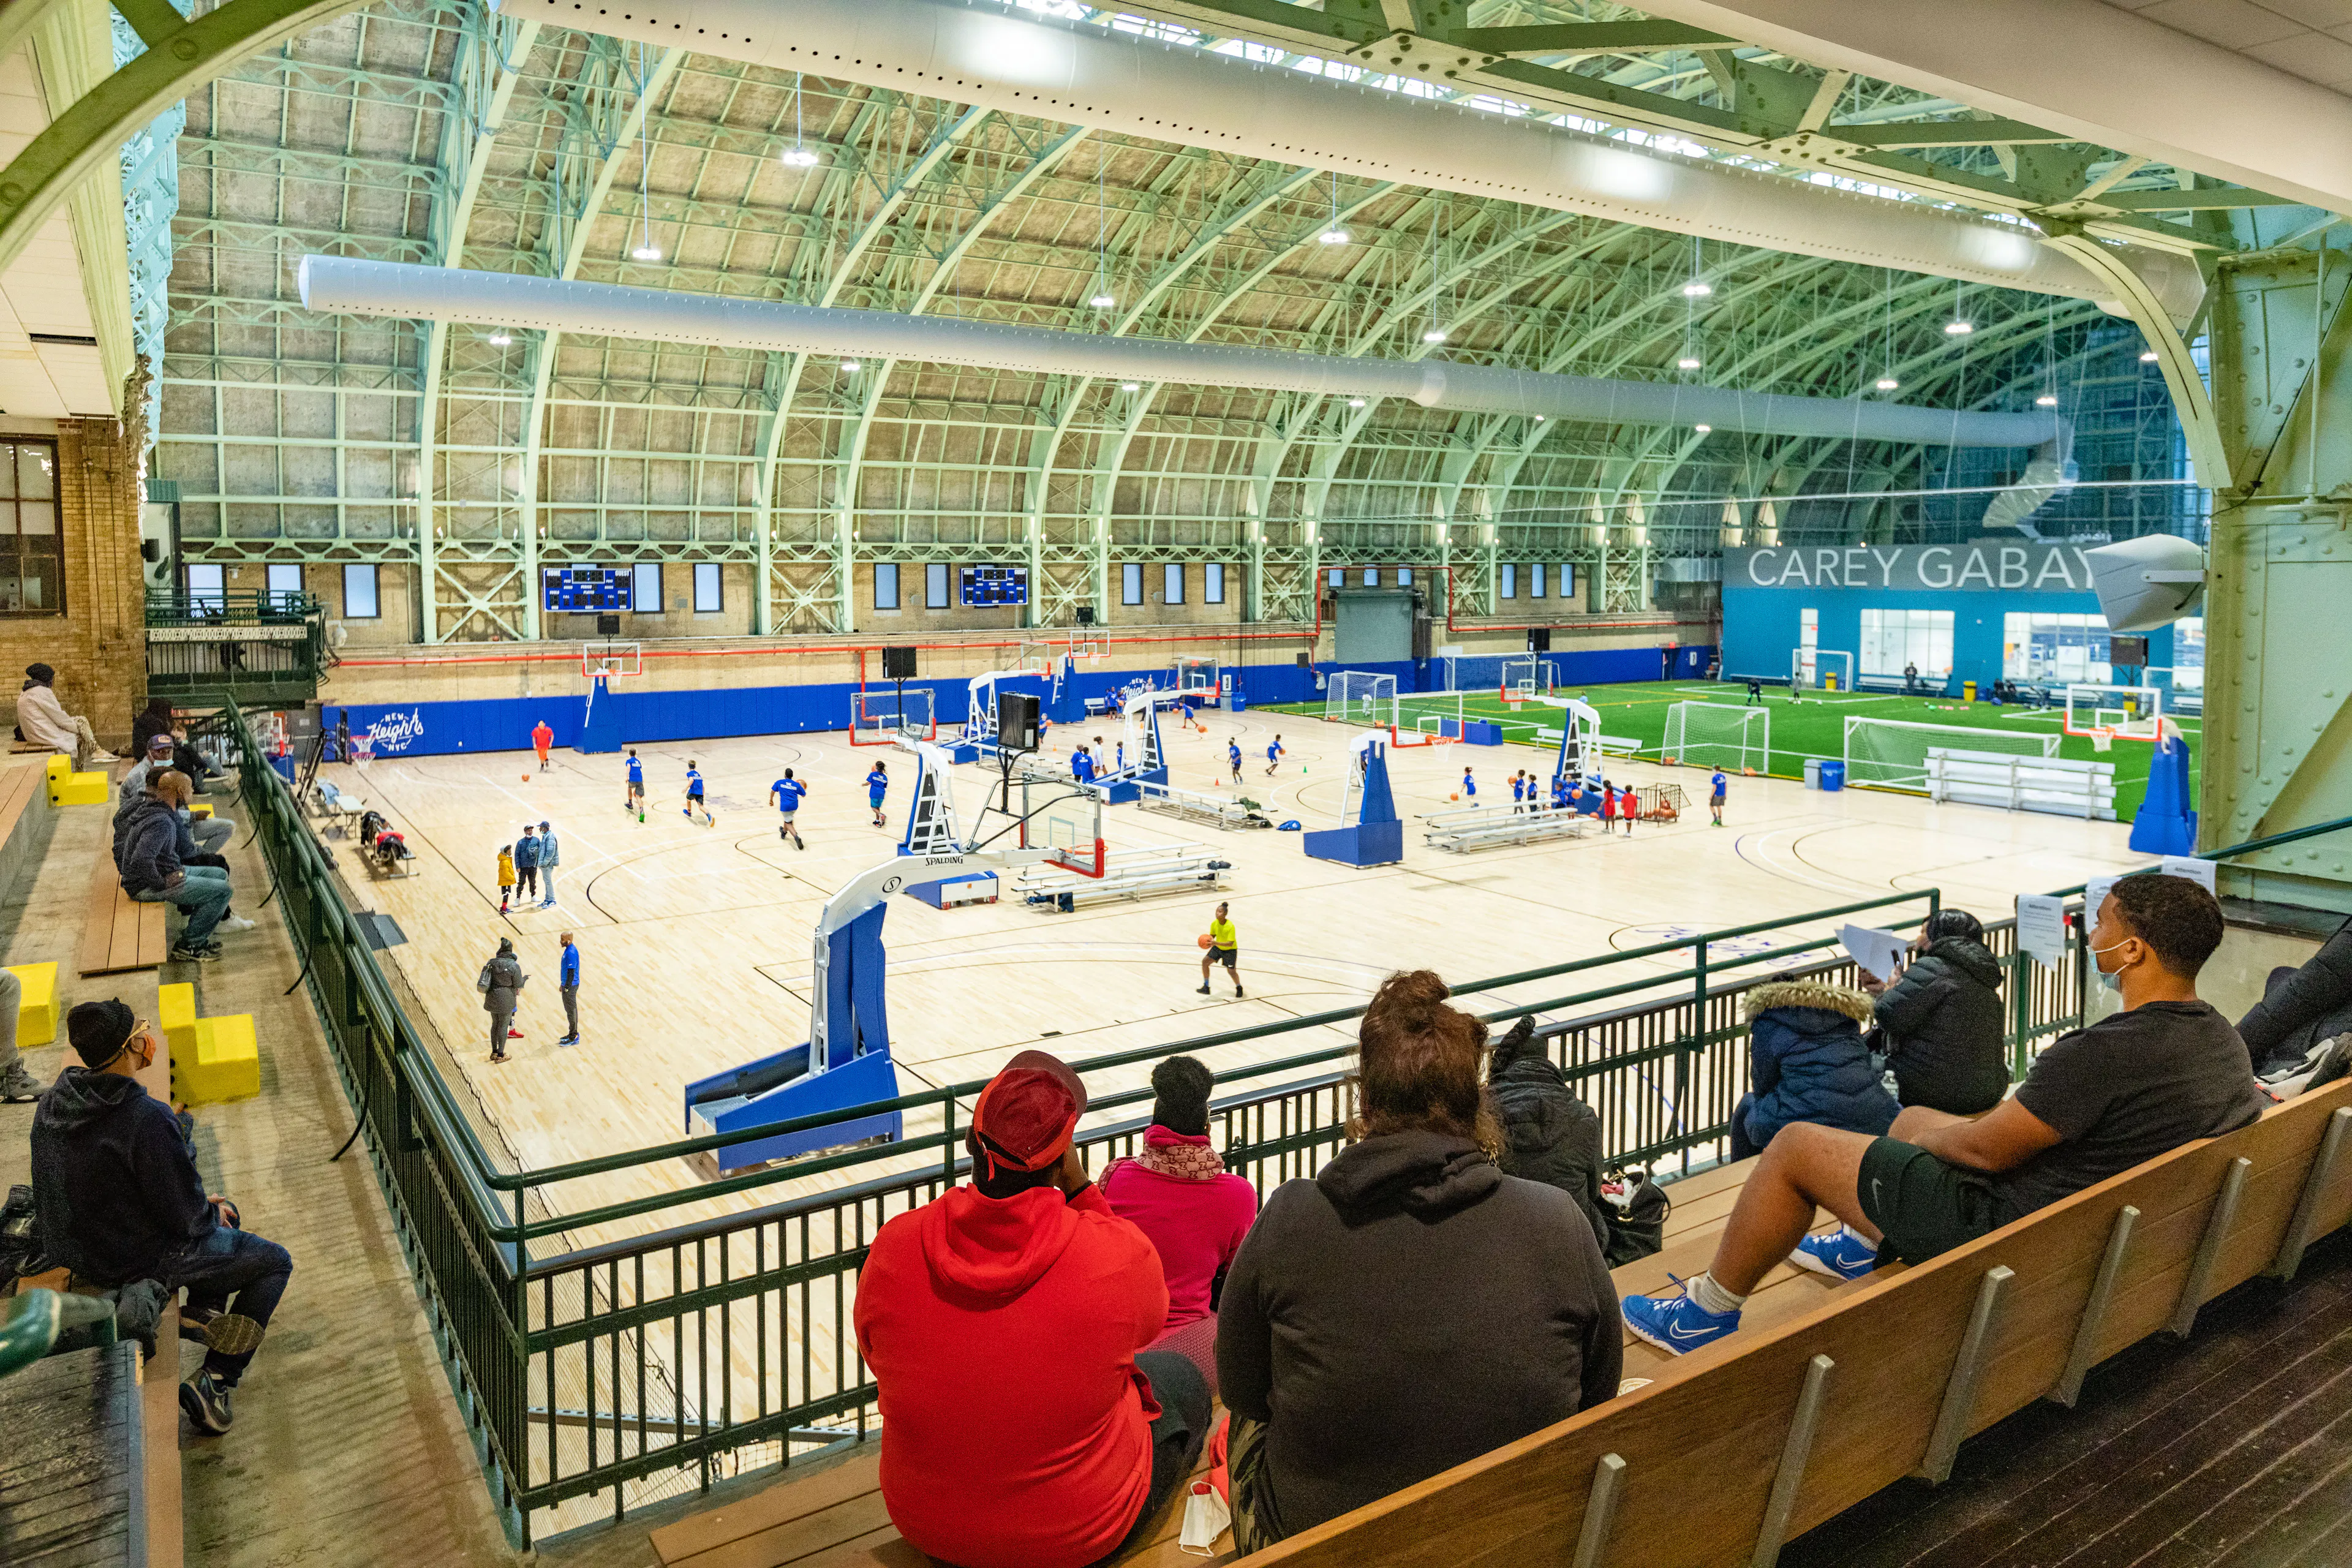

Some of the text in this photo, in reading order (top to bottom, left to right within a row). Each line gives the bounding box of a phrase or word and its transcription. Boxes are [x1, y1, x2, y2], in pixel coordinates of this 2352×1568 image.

[1748, 548, 1902, 587] CAREY
[385, 712, 404, 722] NEW
[366, 707, 424, 744] Heights
[388, 742, 407, 752] NYC
[925, 856, 963, 866] SPALDING
